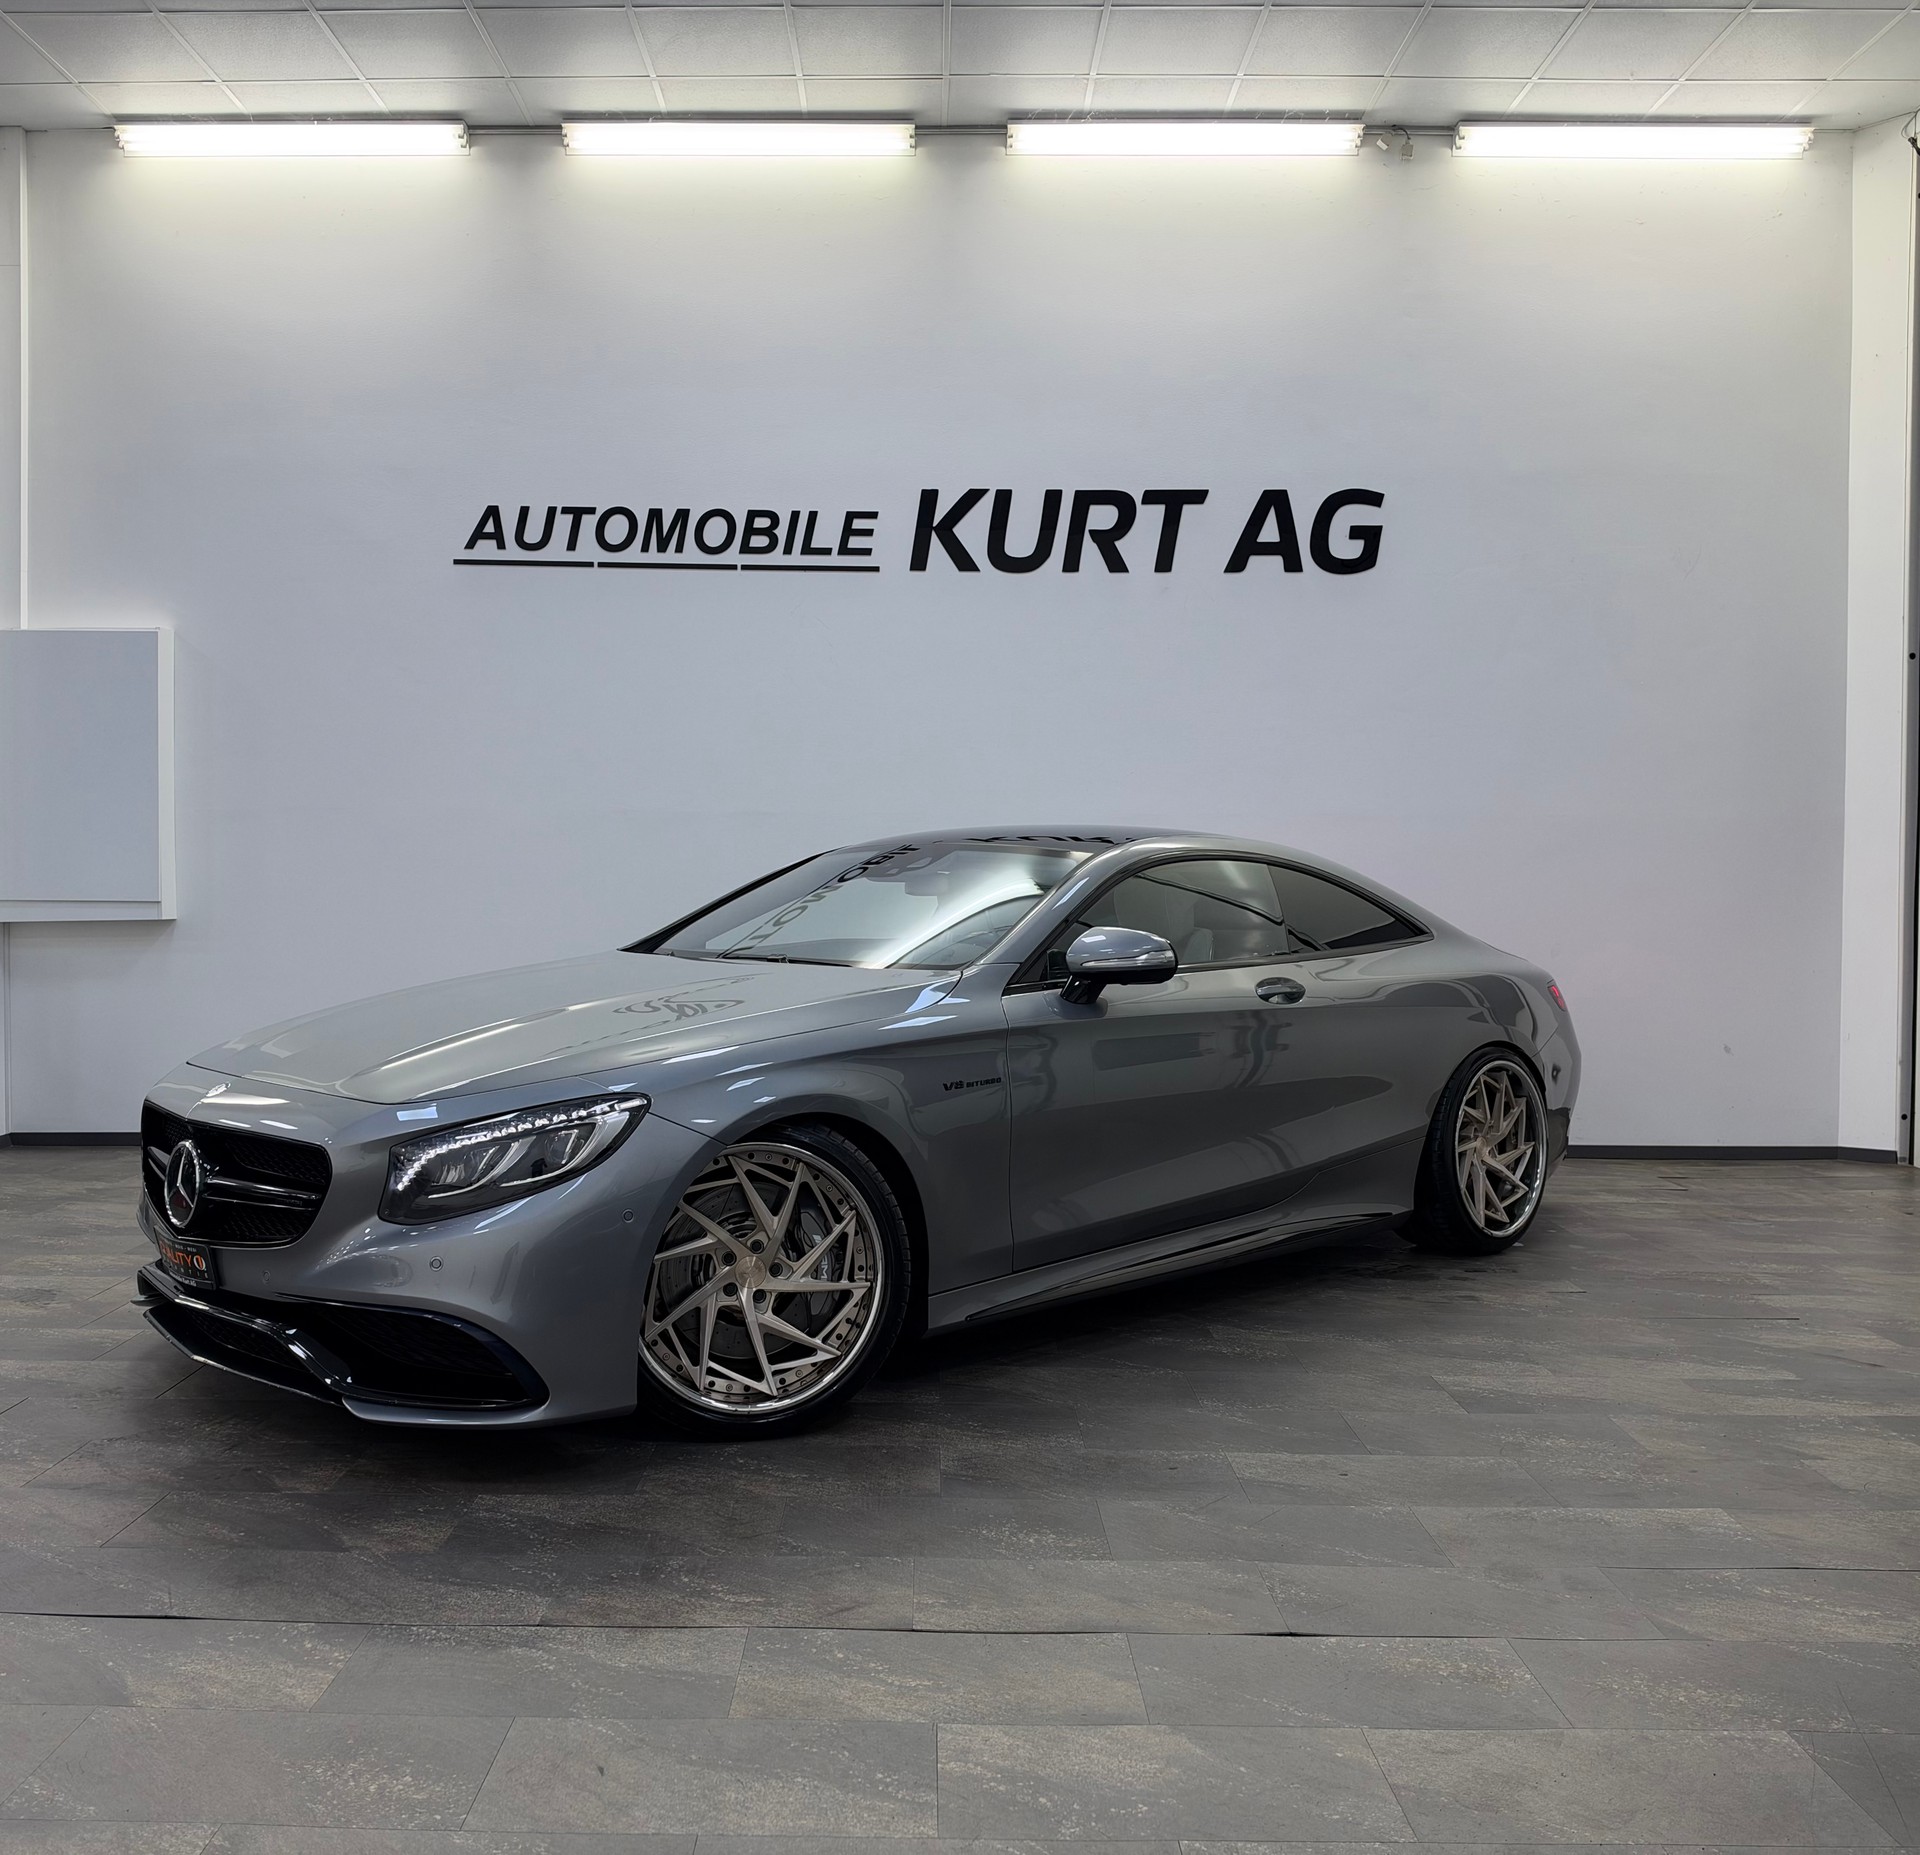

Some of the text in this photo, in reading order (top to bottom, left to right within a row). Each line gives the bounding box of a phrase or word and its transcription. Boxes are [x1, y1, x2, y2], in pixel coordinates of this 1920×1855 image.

[463, 488, 1386, 575] AUTOMOBILE KURT AG
[943, 1077, 1002, 1092] V8 BITURBO
